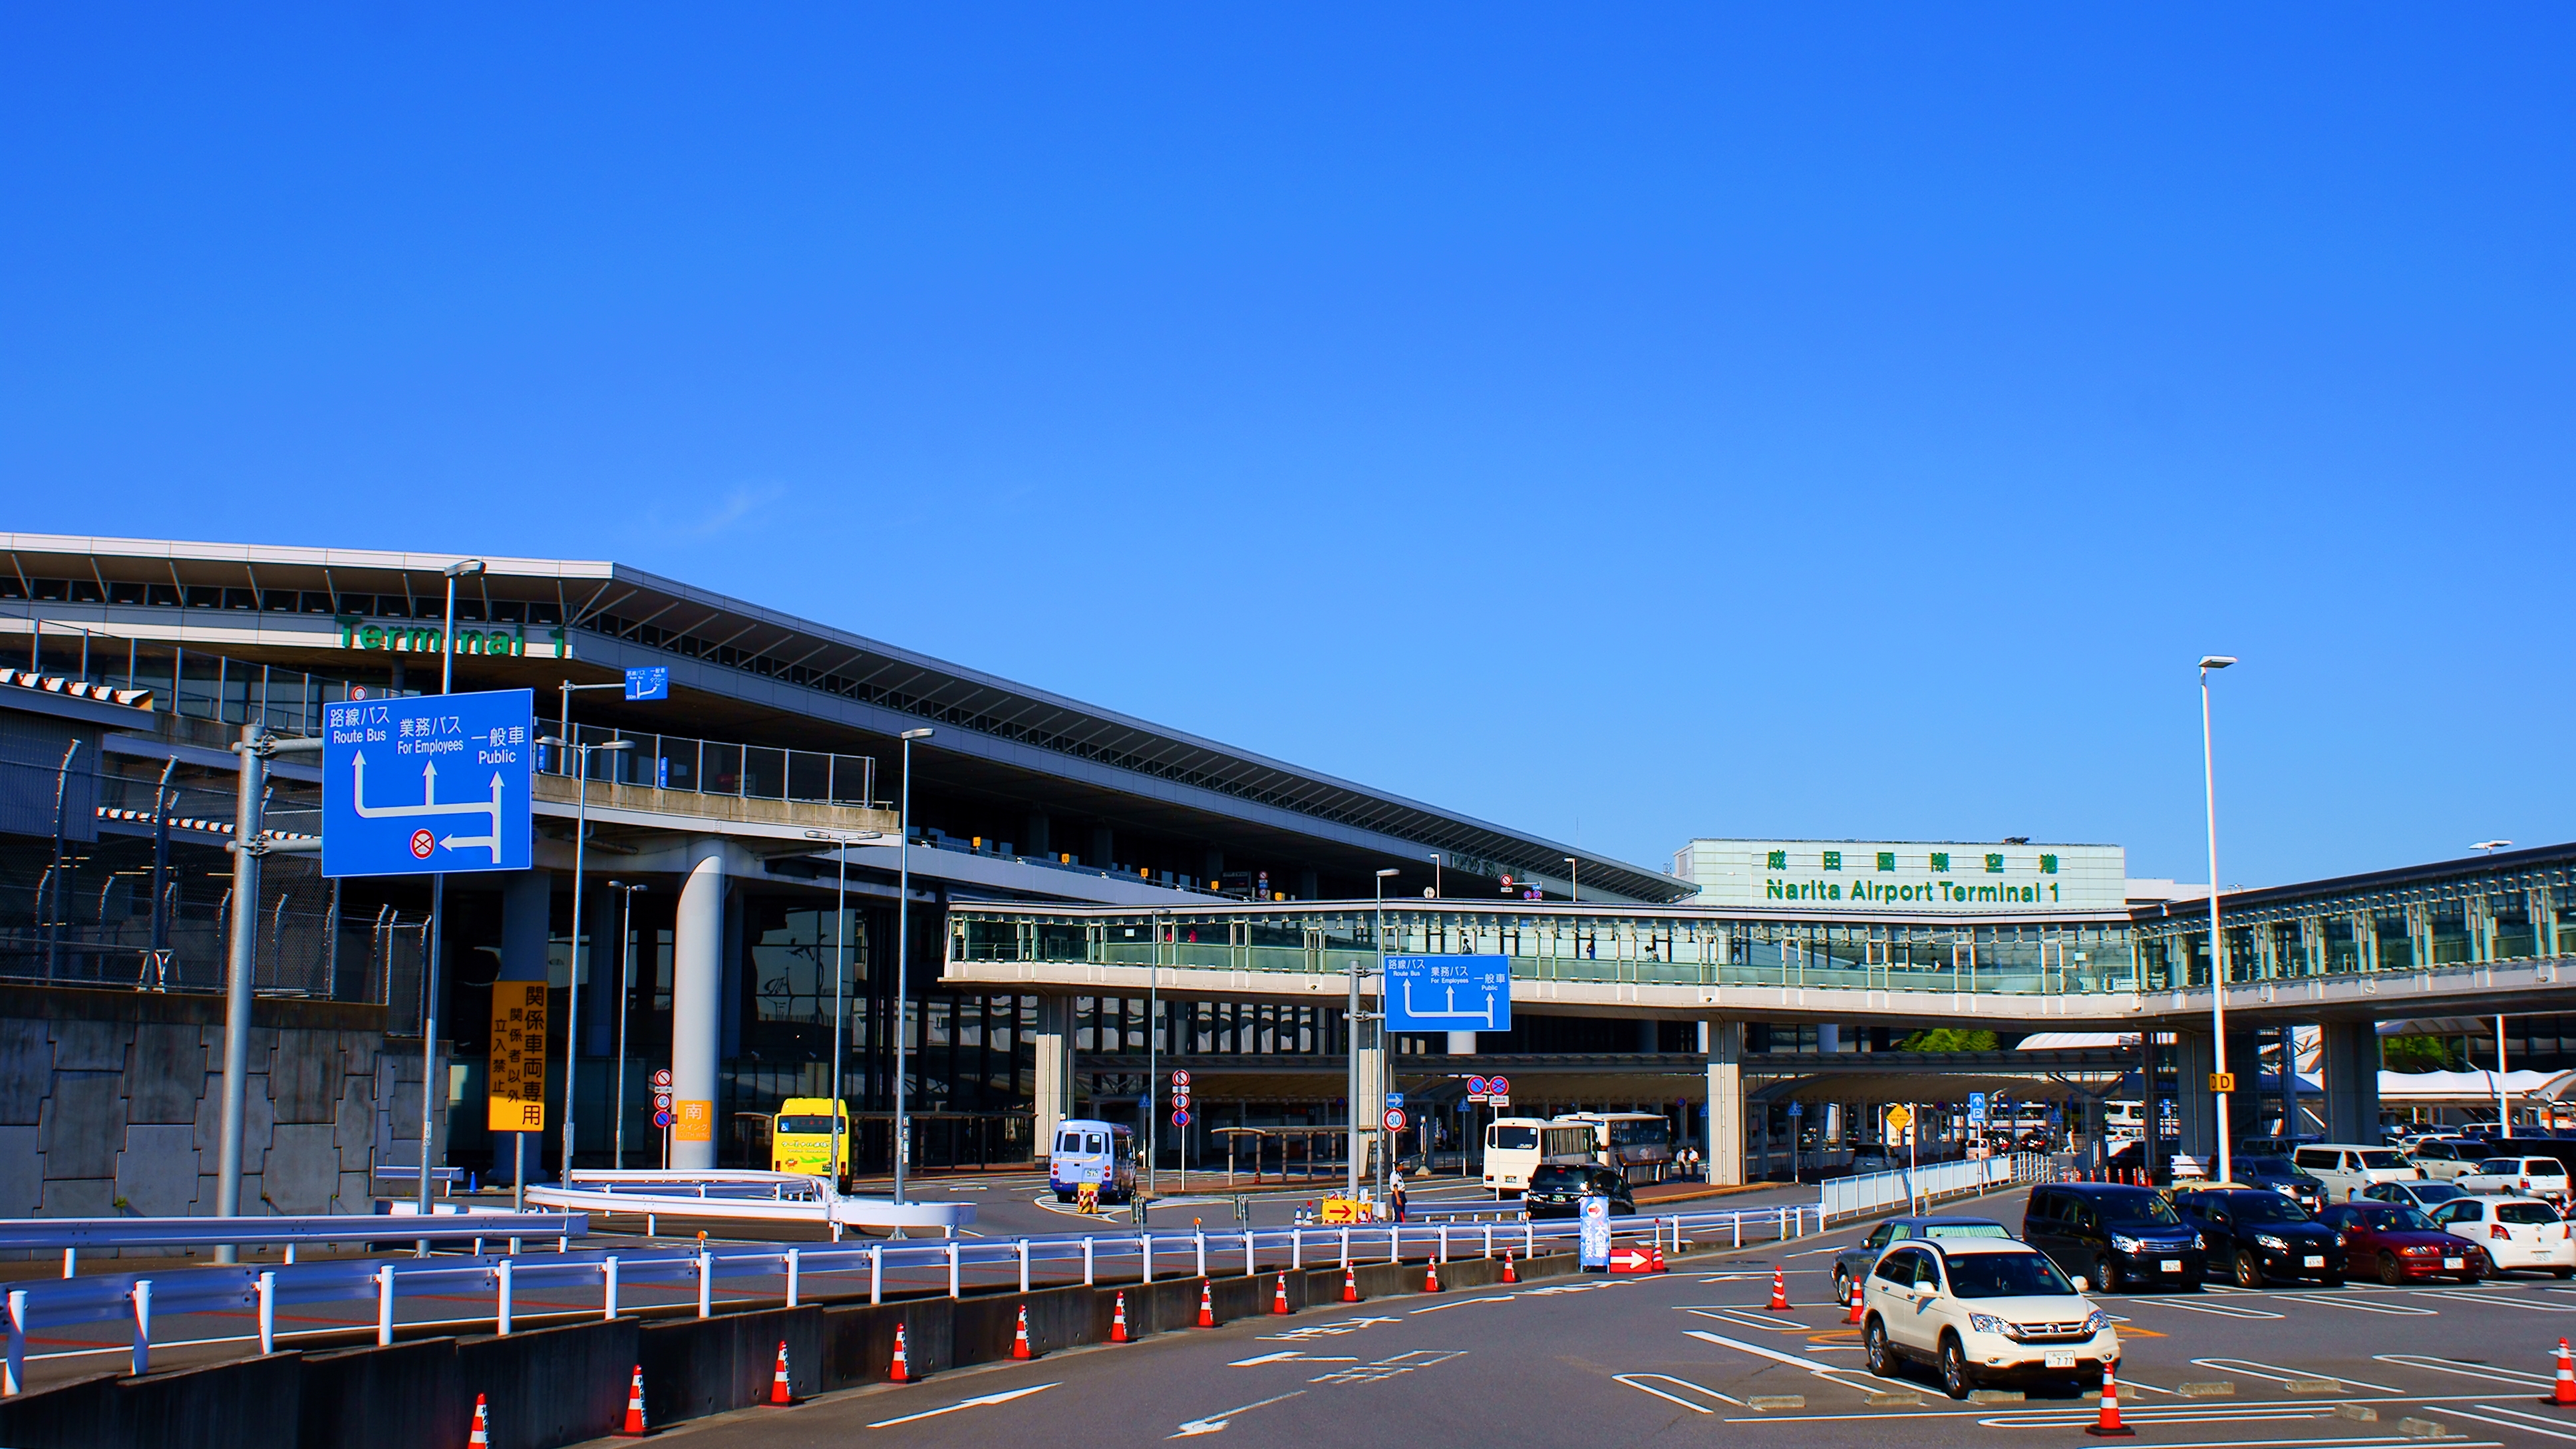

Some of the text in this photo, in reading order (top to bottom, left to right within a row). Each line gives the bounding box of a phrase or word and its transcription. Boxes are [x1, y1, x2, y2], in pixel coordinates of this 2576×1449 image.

[335, 616, 564, 657] Termnal 1
[329, 706, 390, 728] 路線バス
[333, 728, 387, 744] Route Bus
[399, 716, 462, 738] 業務バス
[471, 725, 525, 747] 一般車
[397, 739, 464, 756] For Employees
[478, 750, 516, 764] Public
[1766, 879, 2059, 904] Narita Airport Terminal 1
[1388, 959, 1425, 970] 路線バス
[1430, 966, 1469, 977] 業務バス
[1474, 973, 1506, 984] 一般車
[492, 1019, 508, 1094] 立入禁止
[508, 1008, 523, 1104] 関係者以外
[522, 985, 545, 1126] 関係車両専用
[2220, 1075, 2230, 1088] D
[685, 1102, 703, 1120] 南
[1388, 1114, 1401, 1125] 30
